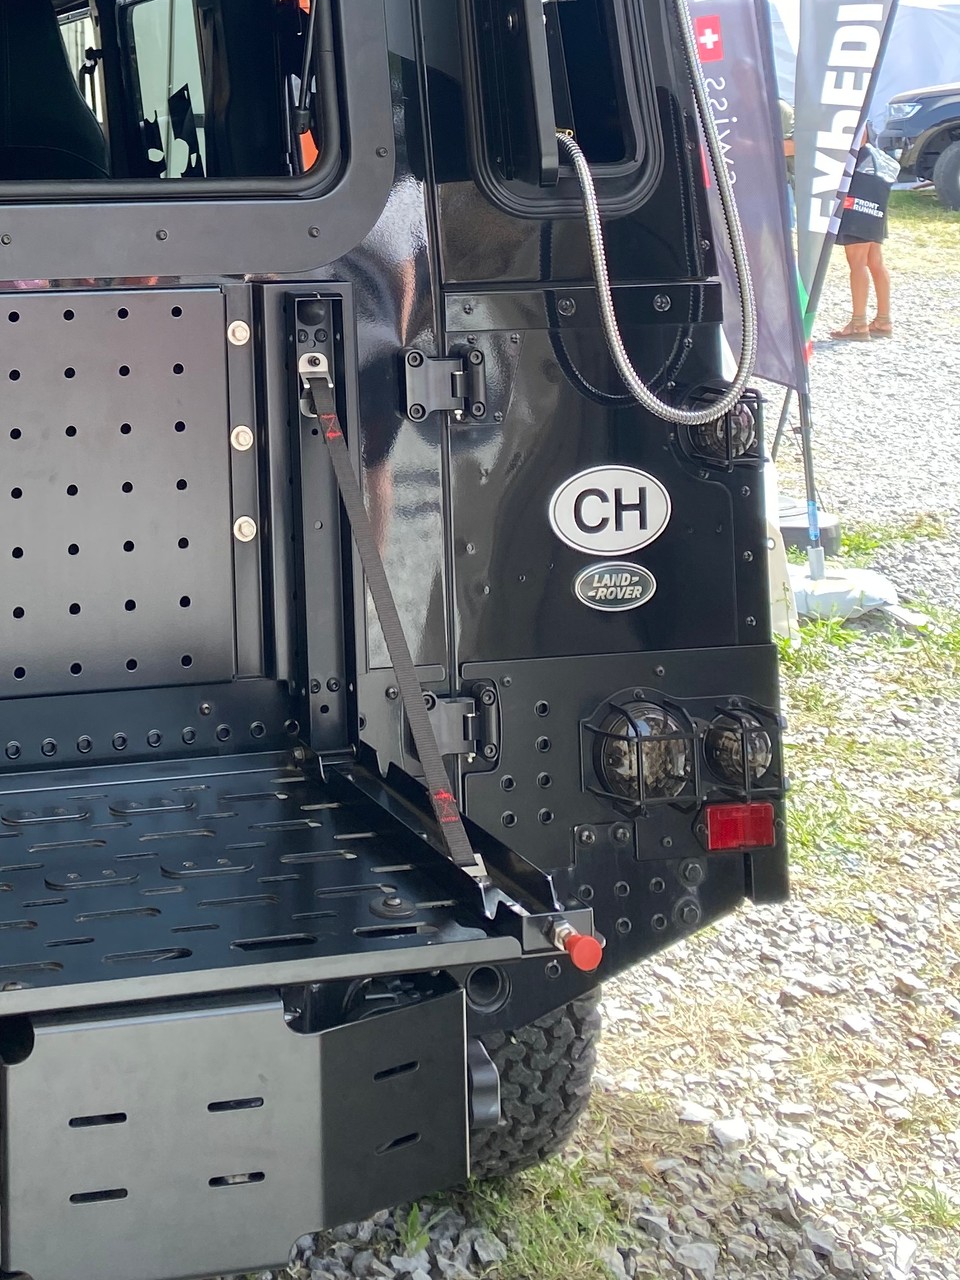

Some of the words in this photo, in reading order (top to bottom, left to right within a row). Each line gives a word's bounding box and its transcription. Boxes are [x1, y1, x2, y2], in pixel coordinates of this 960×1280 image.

[854, 197, 880, 210] FRONT
[852, 205, 884, 218] RUNNER
[573, 486, 648, 535] CH
[592, 572, 632, 588] LAND
[594, 585, 643, 600] ROVER
